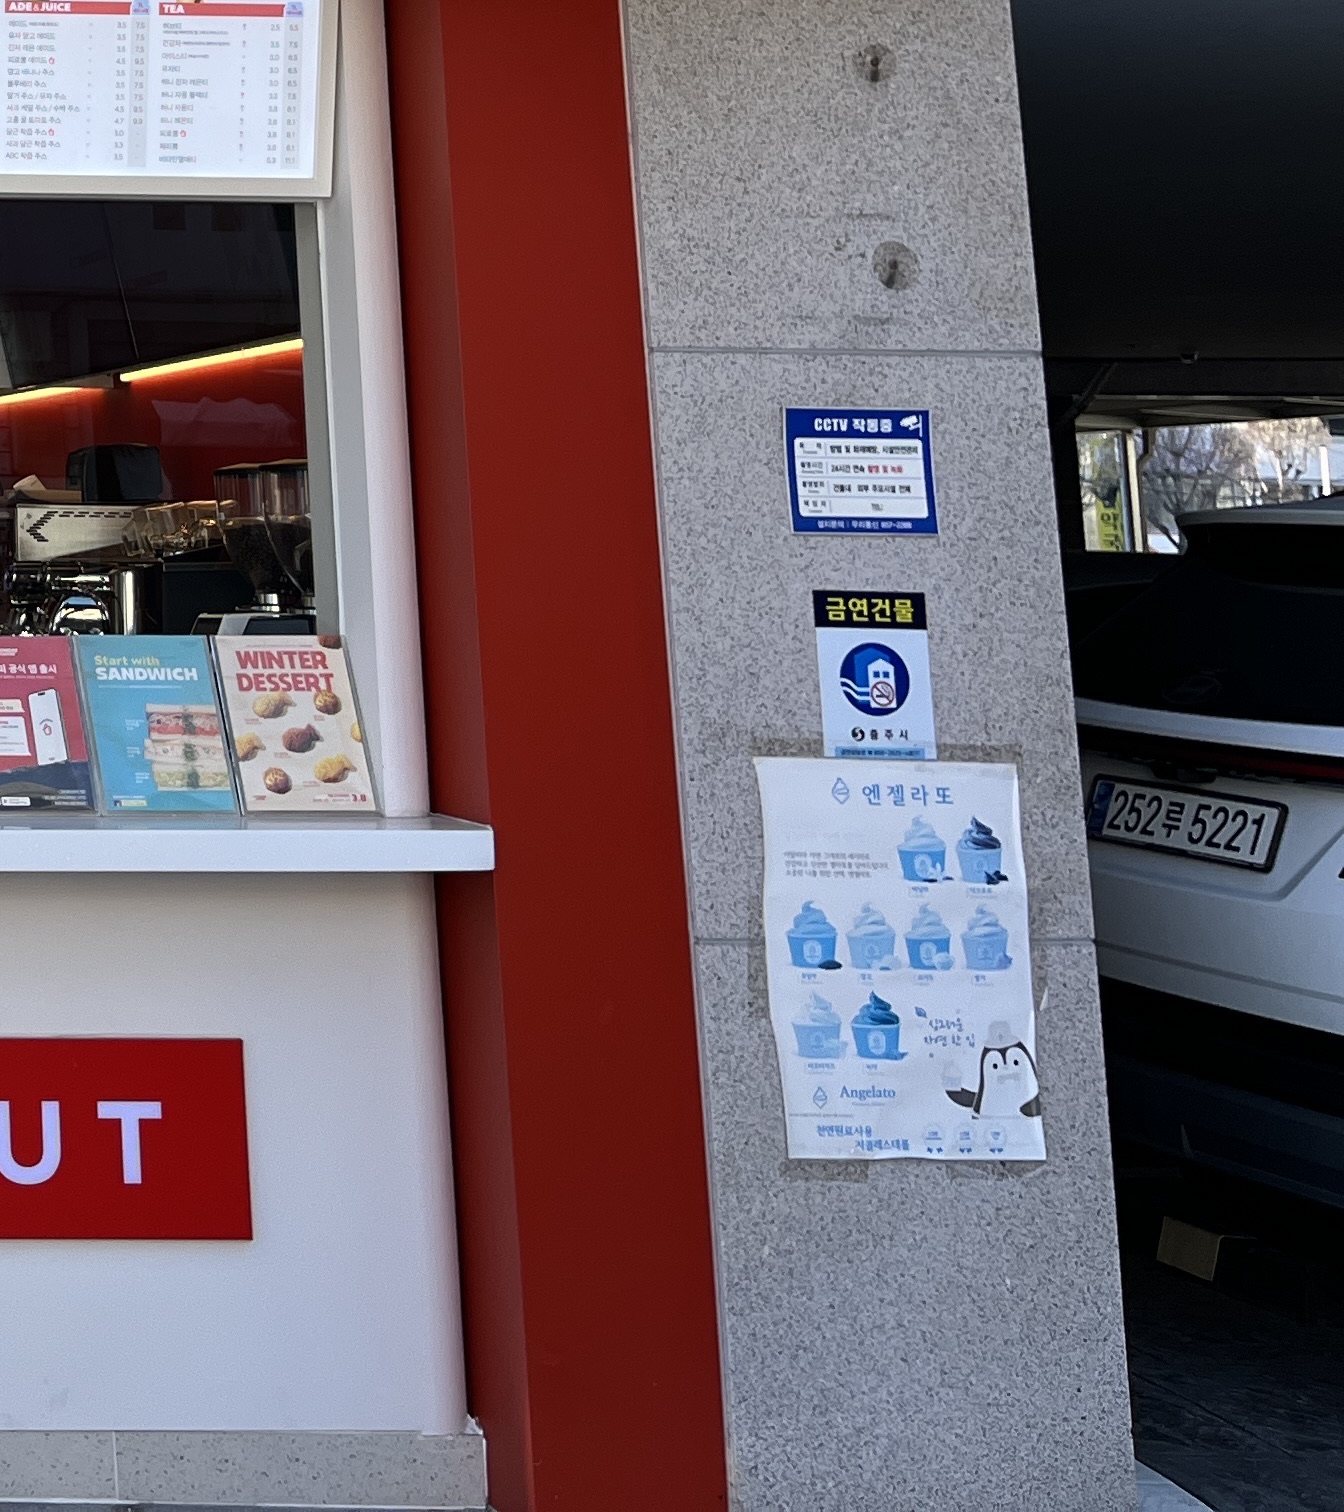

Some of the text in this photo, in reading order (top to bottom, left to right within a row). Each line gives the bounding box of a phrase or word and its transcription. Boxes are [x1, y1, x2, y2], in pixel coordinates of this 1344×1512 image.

[163, 5, 184, 14] TEA
[814, 418, 848, 431] CCTV
[825, 597, 914, 624] 금연건물
[94, 655, 160, 666] Start with
[235, 650, 328, 670] WINTER
[95, 667, 198, 681] SANDWICH
[236, 673, 334, 692] DESSERT
[862, 785, 954, 807] 엔젤라또
[1188, 803, 1267, 857] 5221
[840, 1086, 896, 1100] Angelato
